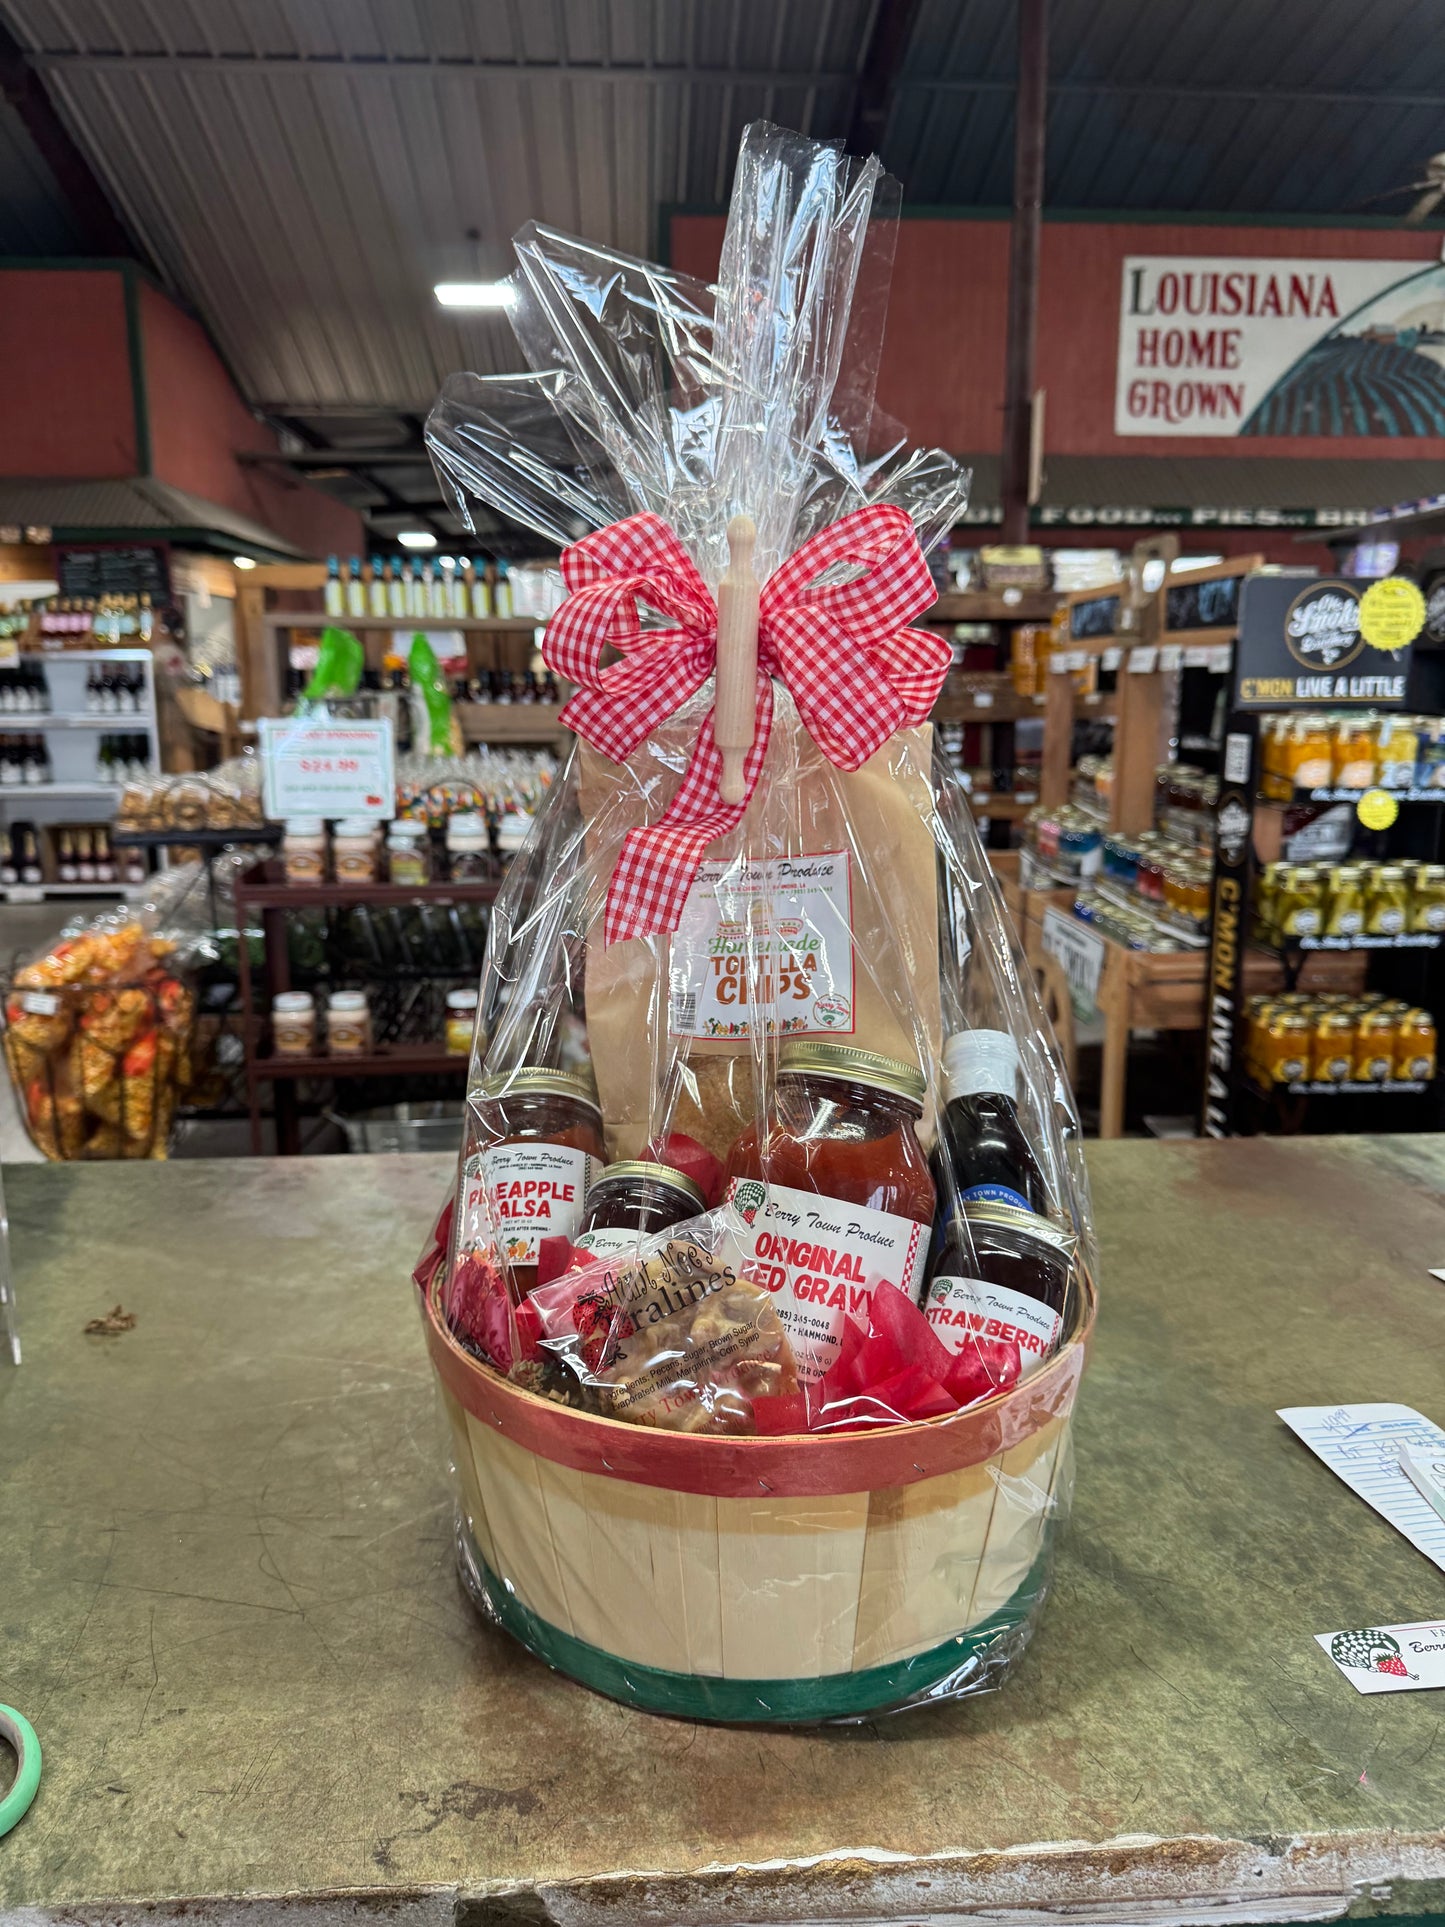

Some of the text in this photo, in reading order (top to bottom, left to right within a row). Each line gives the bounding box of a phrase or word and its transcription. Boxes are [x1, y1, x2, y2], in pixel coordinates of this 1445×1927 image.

[1129, 266, 1340, 318] LOUISIANA
[1136, 328, 1243, 371] HOME
[1126, 378, 1245, 424] GROWN
[1240, 676, 1406, 698] C'MON LIVE A LITTLE
[693, 866, 724, 883] Berr
[1214, 876, 1241, 991] C'MON
[1209, 994, 1235, 1072] LIVE
[1206, 1073, 1229, 1100] A
[515, 1152, 538, 1162] Town
[540, 1152, 574, 1166] Produce
[486, 1199, 551, 1221] ALSA
[972, 1189, 998, 1199] TOWN
[595, 1238, 623, 1249] Berry
[764, 1202, 896, 1248] Berry Town Produce
[755, 1231, 867, 1284] ORIGINAL
[610, 1265, 737, 1334] ralines
[776, 1308, 830, 1330] 85) 345-0048
[951, 1287, 1052, 1331] Berry Town Produce
[924, 1306, 1050, 1359] STRAWBERRY
[605, 1375, 651, 1401] ngredients:
[650, 1358, 684, 1379] Pecans,
[709, 1332, 733, 1350] Brown
[732, 1320, 757, 1342] Sugar,
[612, 1383, 656, 1411] Evaporated
[719, 1342, 739, 1358] Corn
[738, 1331, 760, 1351] Syrup
[797, 1364, 812, 1376] TER
[633, 1408, 657, 1426] rry
[1408, 1640, 1445, 1654] Berr
